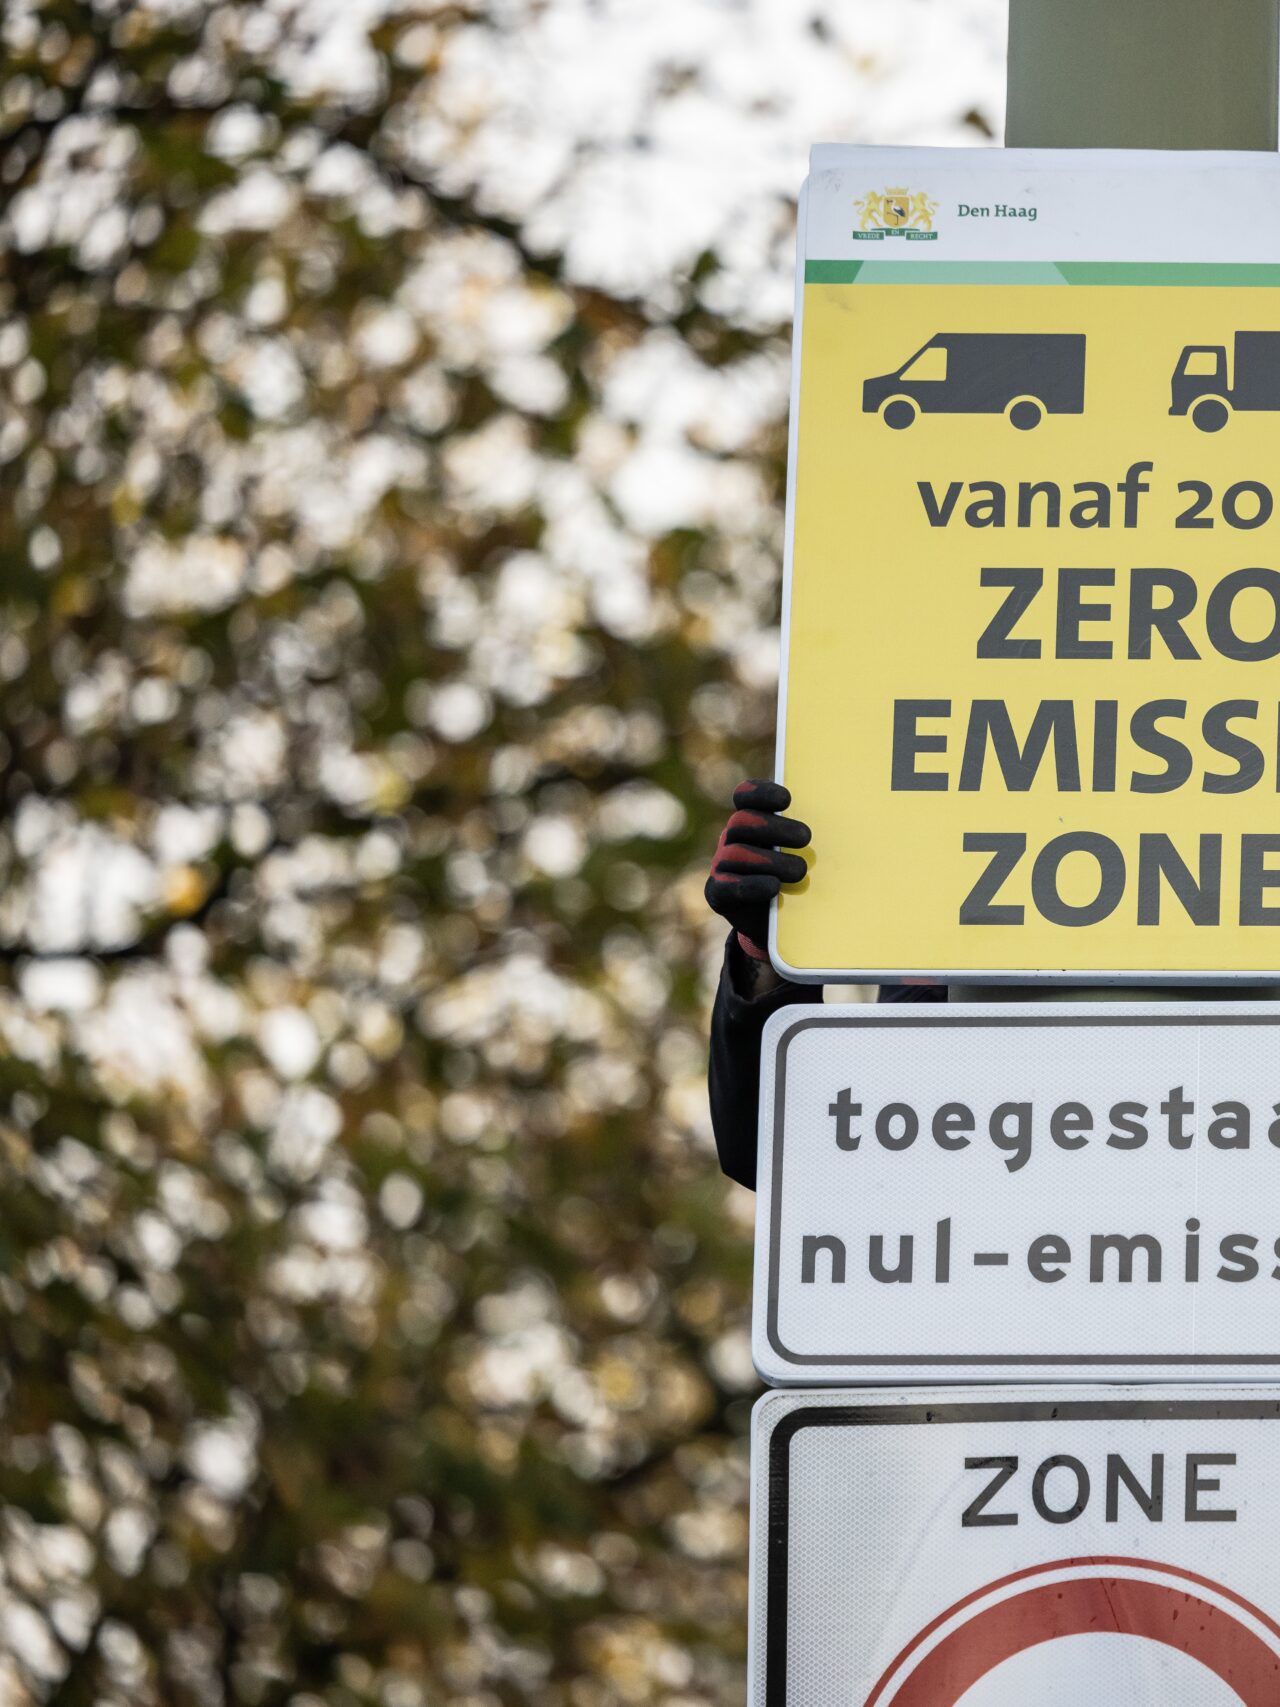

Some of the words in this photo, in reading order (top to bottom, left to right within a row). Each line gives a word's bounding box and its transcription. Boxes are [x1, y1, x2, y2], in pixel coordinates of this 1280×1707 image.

[957, 204, 990, 218] Den
[994, 204, 1038, 222] Haag
[917, 462, 1153, 528] vanaf
[962, 1453, 1236, 1527] ZONE
